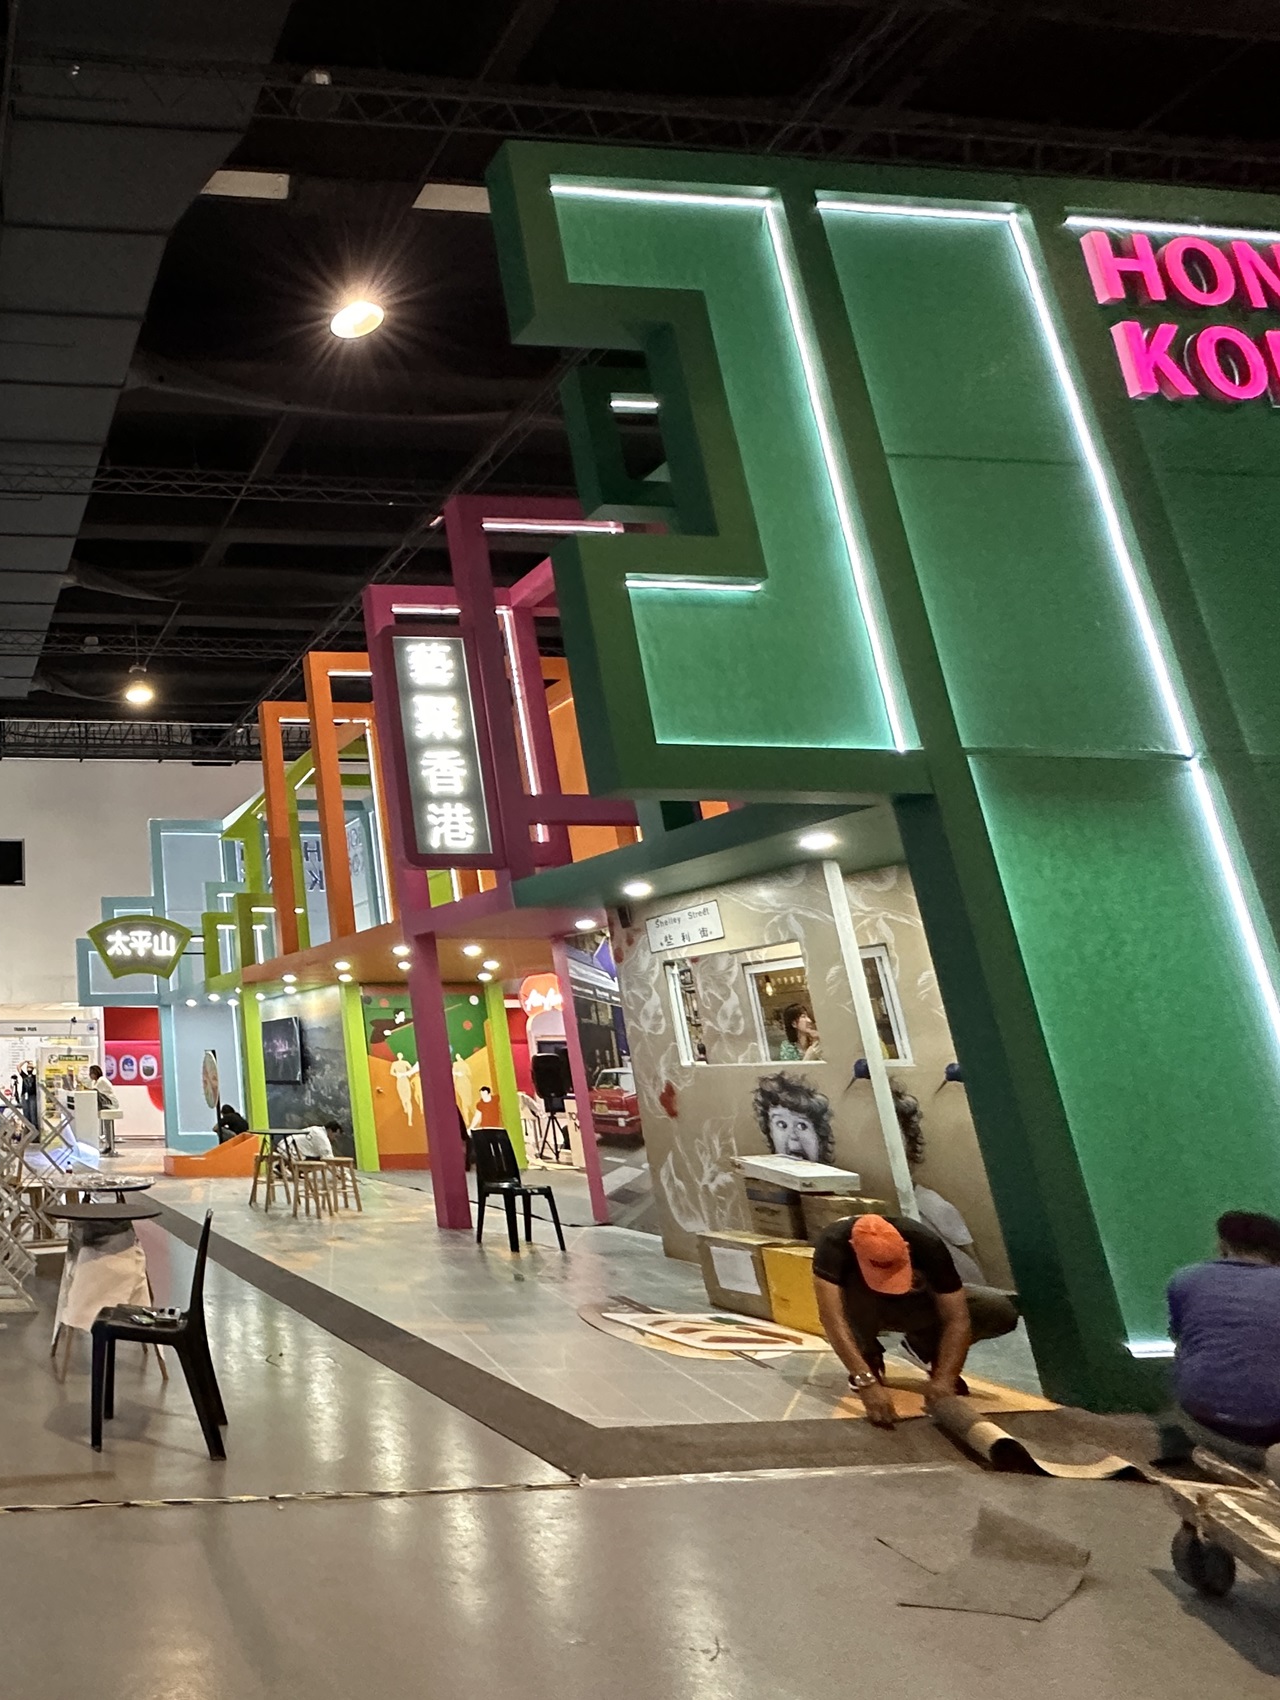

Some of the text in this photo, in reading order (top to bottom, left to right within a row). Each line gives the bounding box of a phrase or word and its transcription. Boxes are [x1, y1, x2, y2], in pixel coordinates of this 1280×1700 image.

[655, 907, 710, 929] Shelley Street
[106, 929, 176, 957] 太平山
